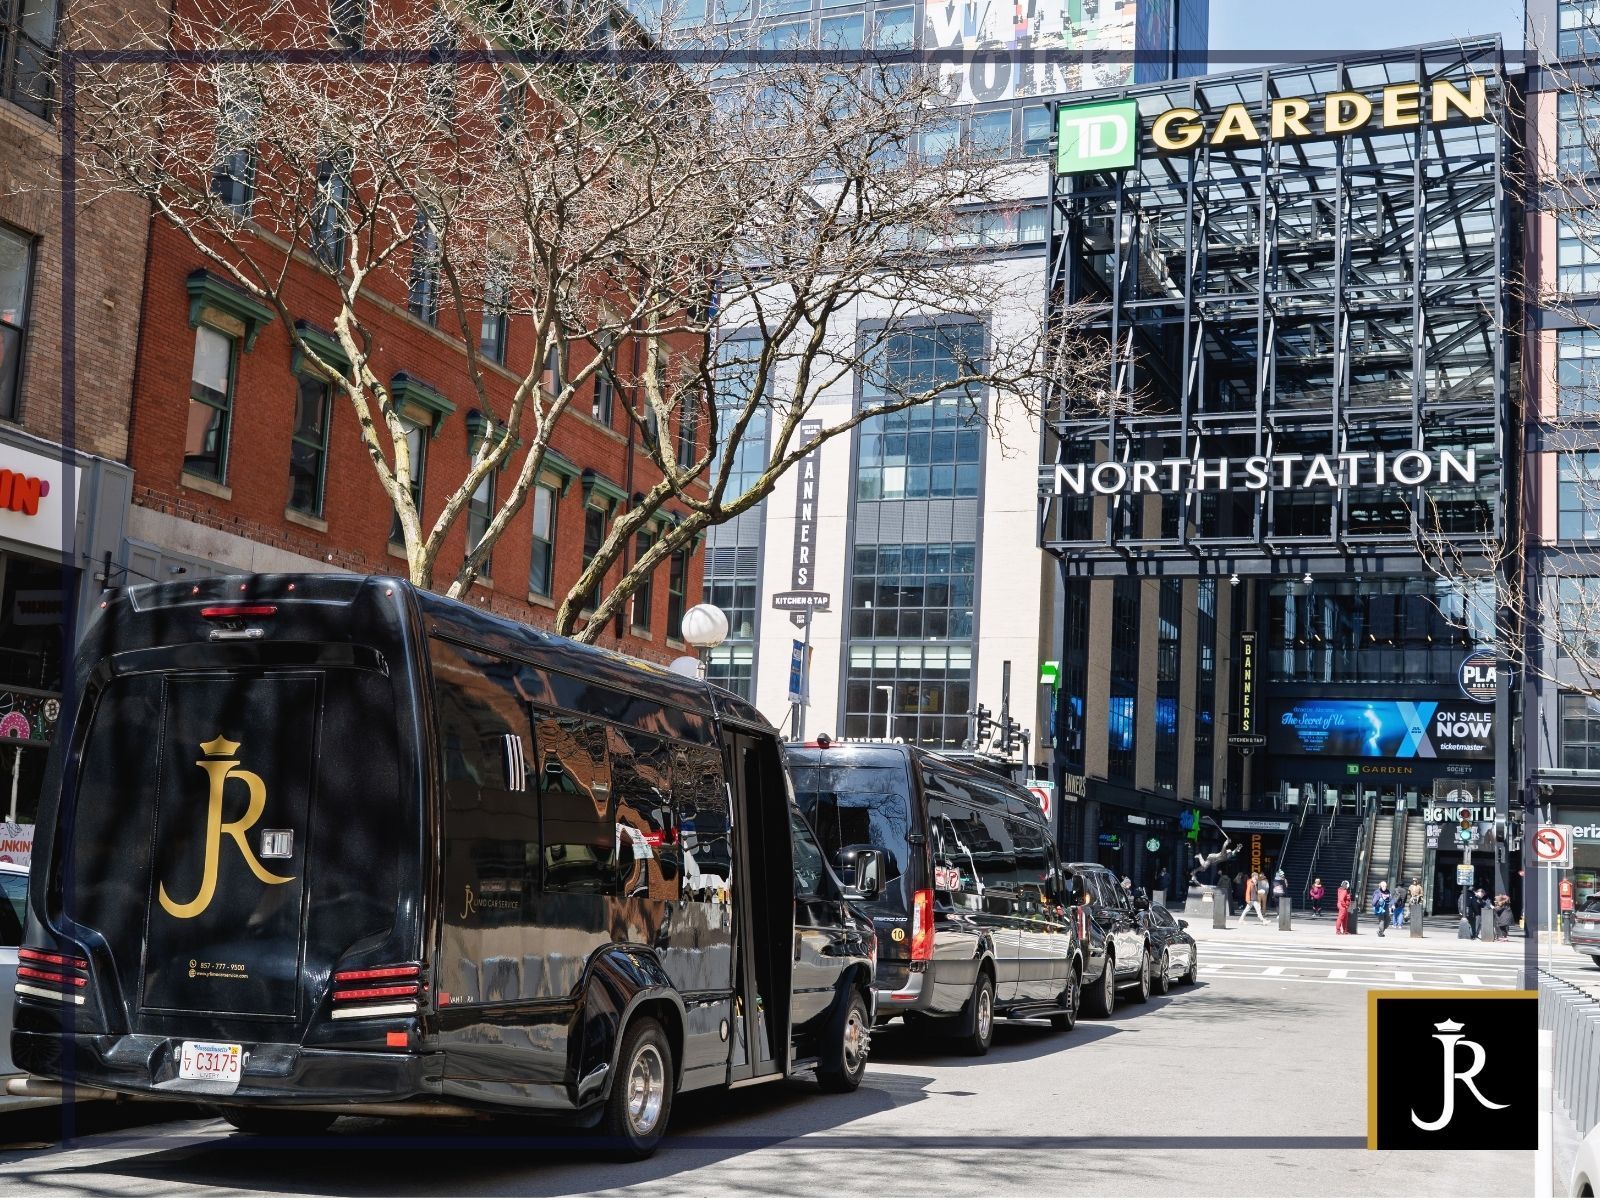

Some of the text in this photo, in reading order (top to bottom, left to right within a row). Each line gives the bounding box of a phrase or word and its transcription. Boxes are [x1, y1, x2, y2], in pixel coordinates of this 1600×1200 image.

[1066, 76, 1487, 159] TD GARDEN
[1053, 448, 1478, 496] NORTH STATION
[775, 597, 828, 605] KITCHEN & TAP
[1242, 644, 1252, 732] BANNERS
[1281, 712, 1345, 730] The Secret of Us
[1436, 711, 1492, 723] ON SALE
[1436, 722, 1492, 738] NOW
[1440, 743, 1484, 751] ticketmaster
[1362, 765, 1413, 774] GARDEN
[1446, 765, 1473, 773] SOCIETY
[1423, 808, 1443, 822] BIG
[893, 930, 903, 939] 10
[196, 1052, 238, 1072] C3175
